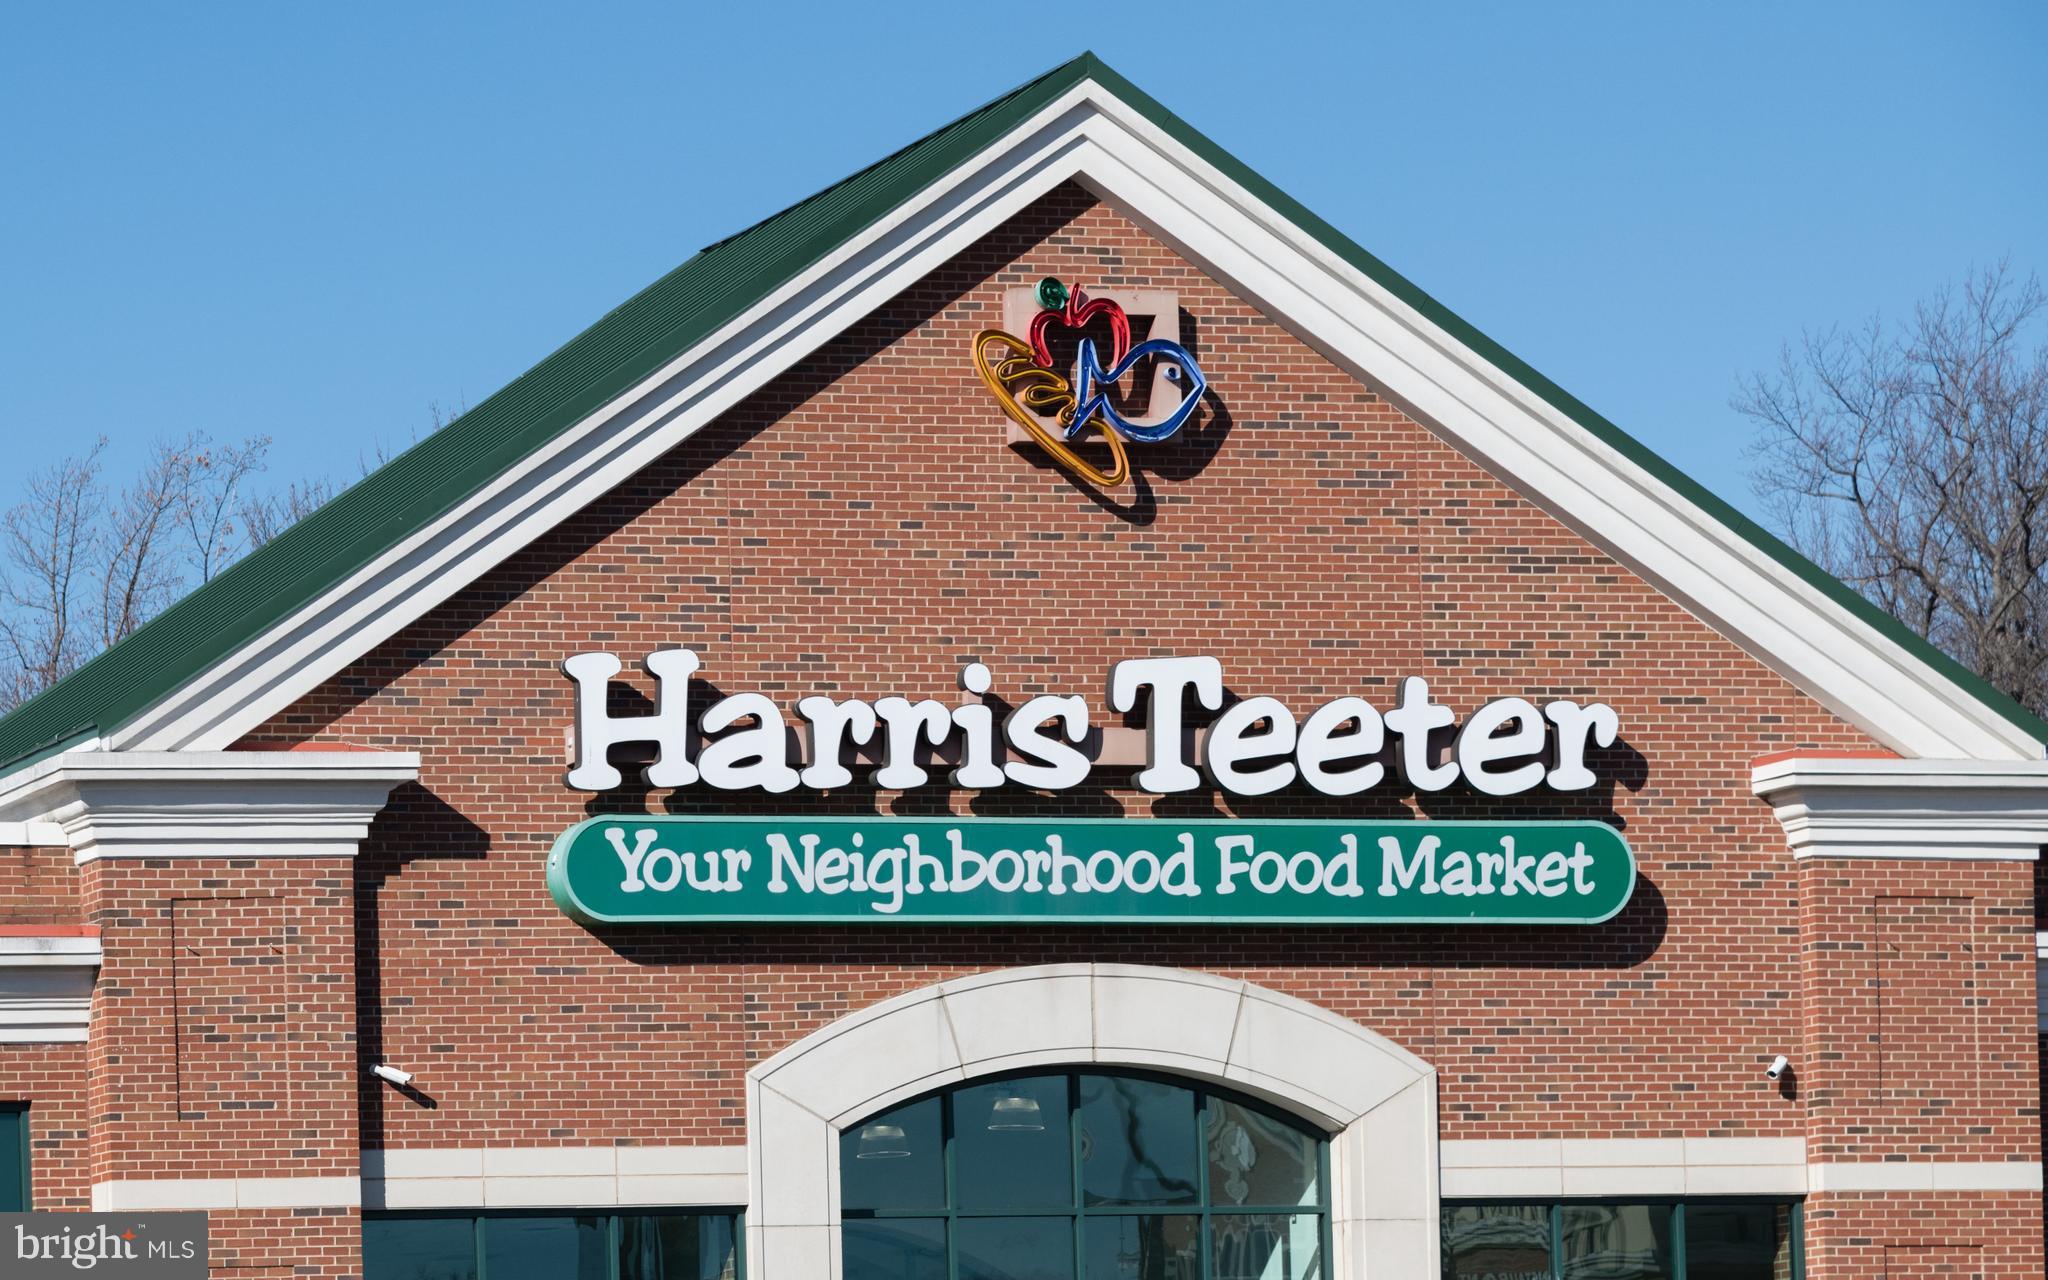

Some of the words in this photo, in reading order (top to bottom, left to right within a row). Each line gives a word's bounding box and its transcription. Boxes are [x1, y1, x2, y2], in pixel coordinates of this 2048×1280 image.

[562, 648, 1091, 793] Harris
[1110, 655, 1619, 796] Teeter
[604, 827, 752, 893] Your
[766, 828, 1202, 914] Neighborhood
[1215, 832, 1365, 897] Food
[1377, 834, 1597, 897] Market
